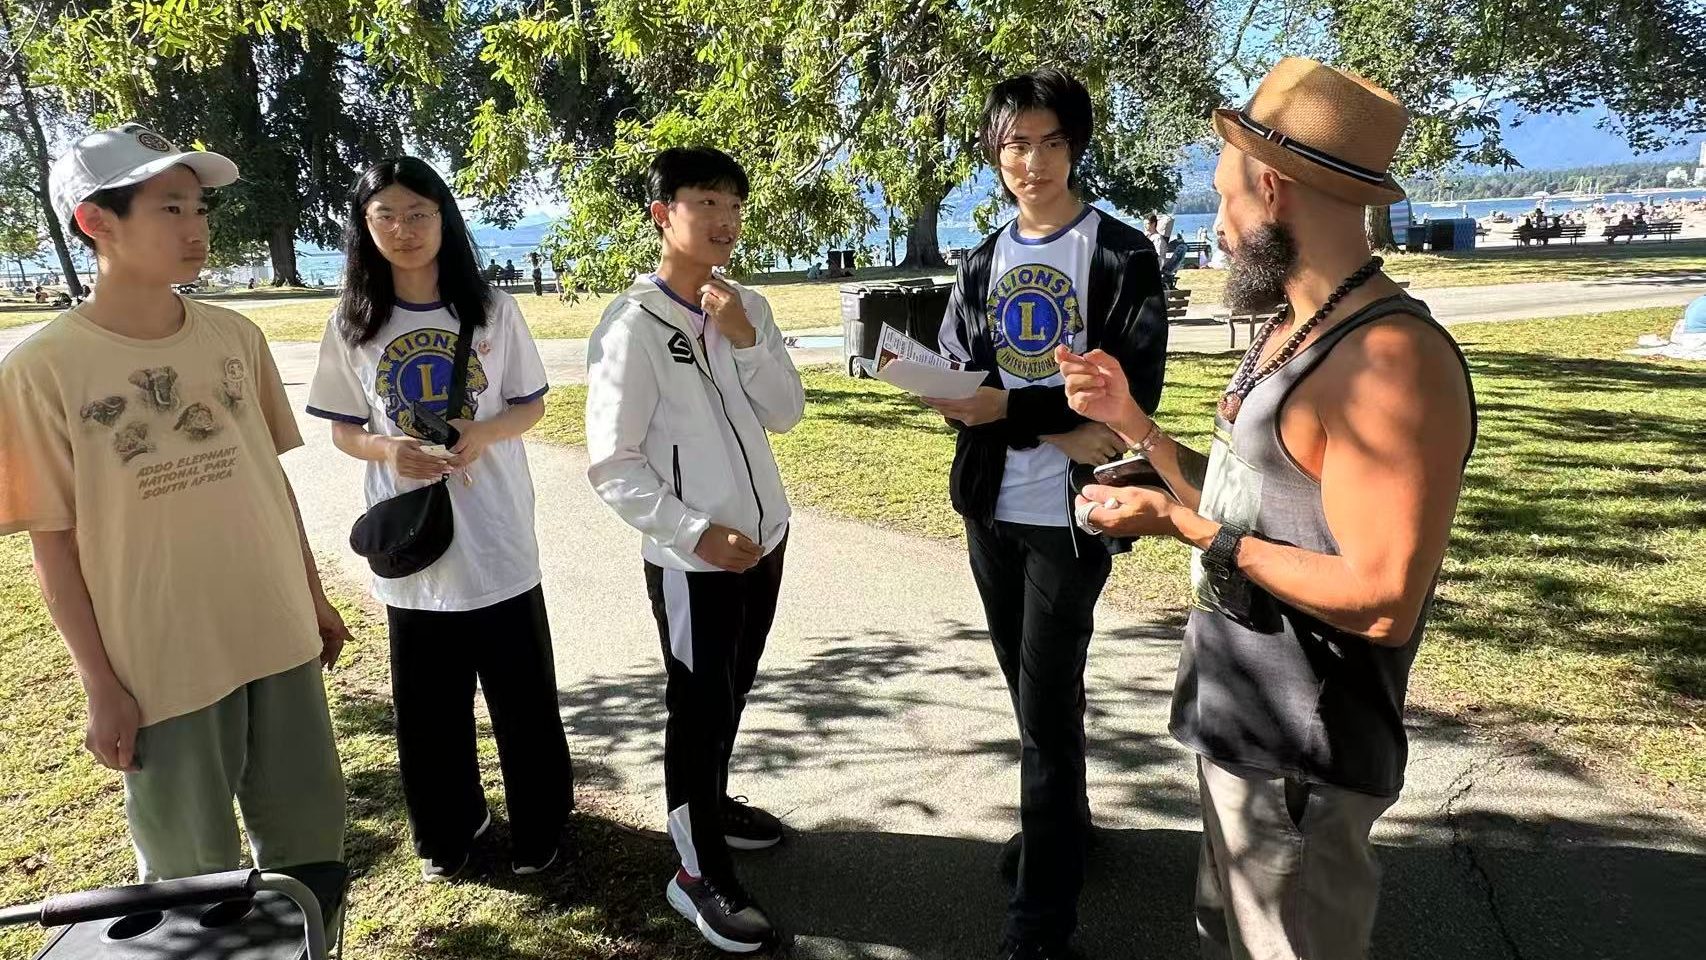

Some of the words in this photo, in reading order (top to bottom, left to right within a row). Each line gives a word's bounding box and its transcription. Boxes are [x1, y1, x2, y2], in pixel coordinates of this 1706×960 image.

[1000, 269, 1066, 294] LIONS
[1018, 301, 1046, 341] L
[391, 332, 461, 357] LION
[1001, 351, 1058, 374] INTERNATIONA
[417, 363, 449, 402] L
[136, 461, 174, 480] ADDO
[176, 446, 238, 469] ELEPHANT
[138, 466, 200, 490] NATIONAL
[203, 457, 237, 473] PARK
[142, 480, 188, 501] SOUTH
[190, 469, 233, 488] AFRICA
